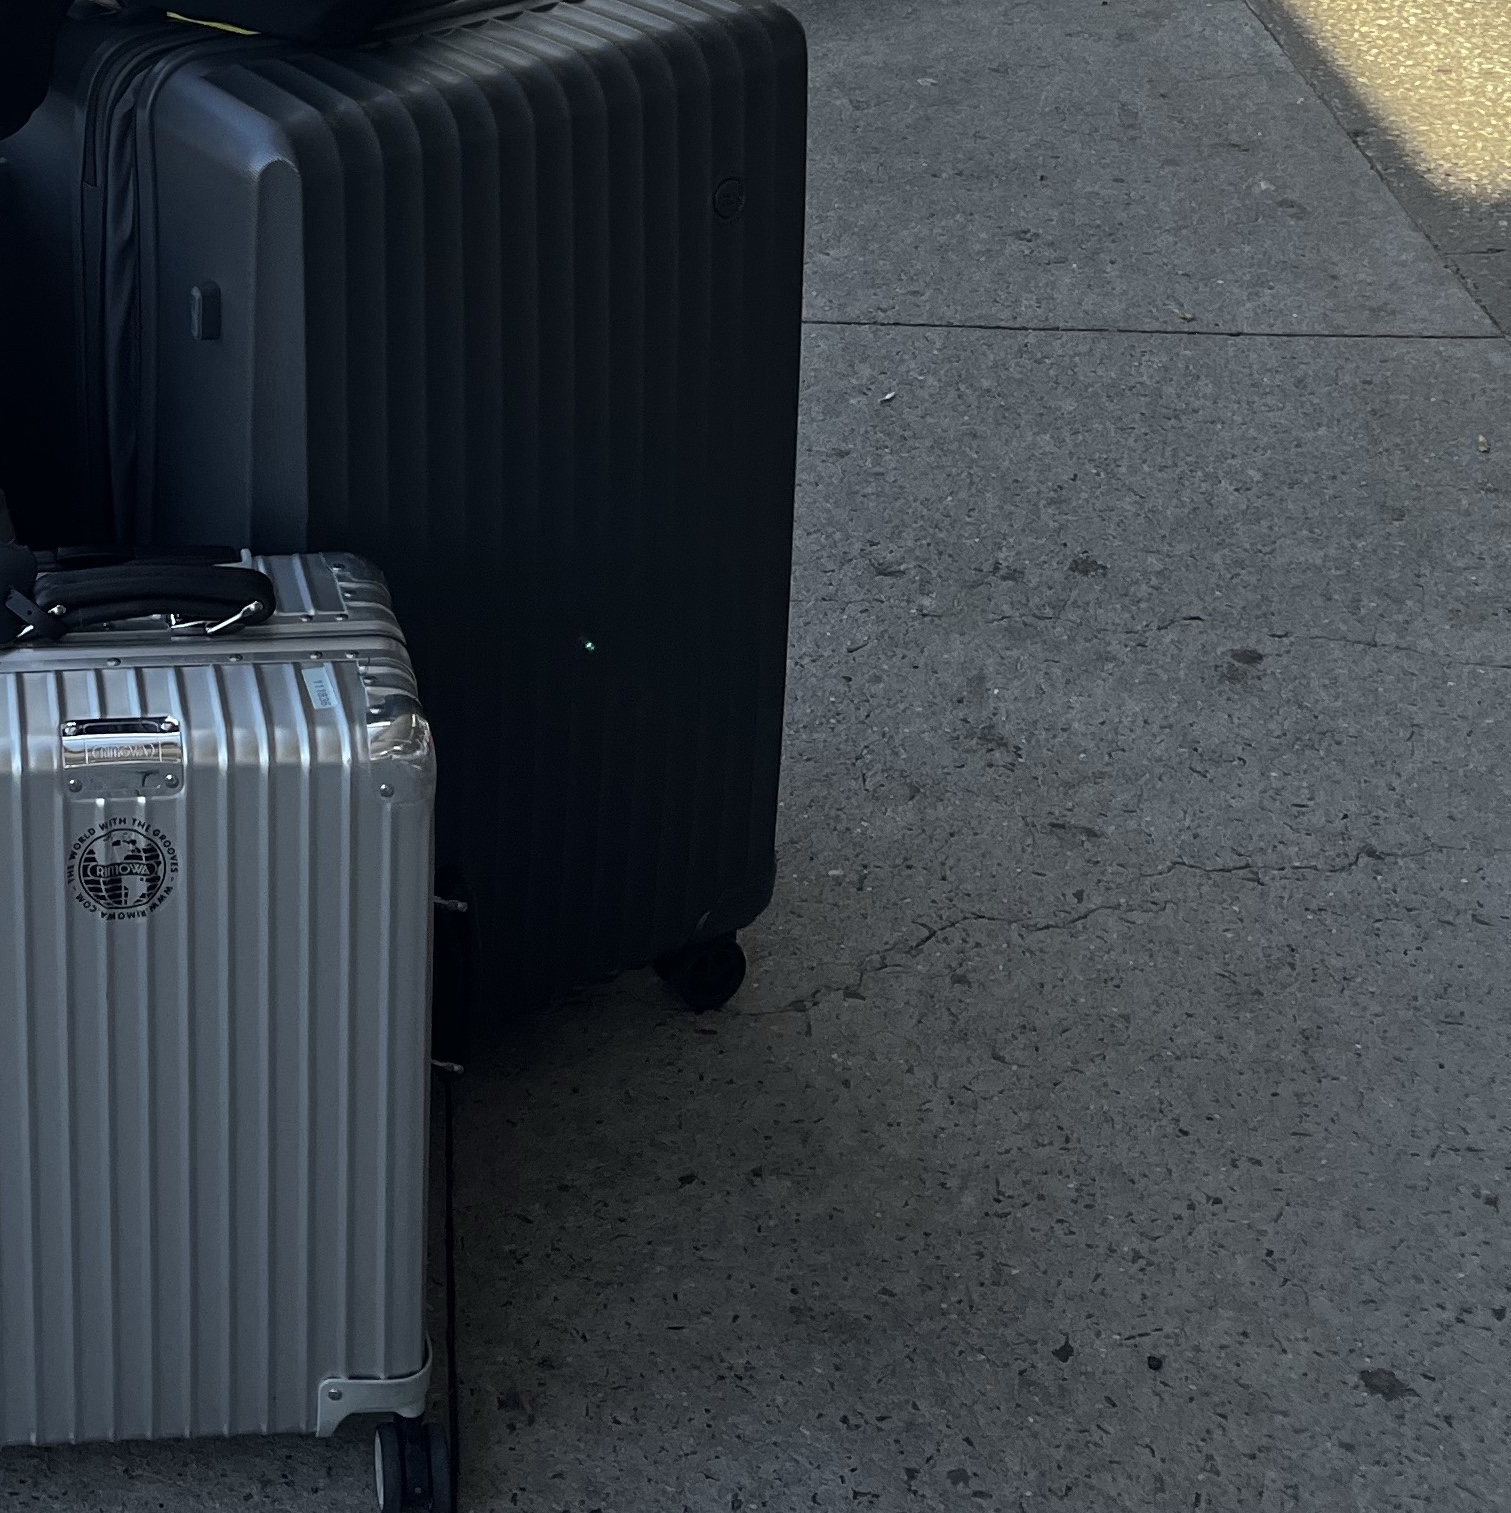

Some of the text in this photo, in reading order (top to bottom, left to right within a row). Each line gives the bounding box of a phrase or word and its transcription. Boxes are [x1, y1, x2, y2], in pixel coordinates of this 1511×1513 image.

[66, 817, 179, 885] THE WORLD WITH THE GROOVES
[96, 862, 152, 878] RIMOWA
